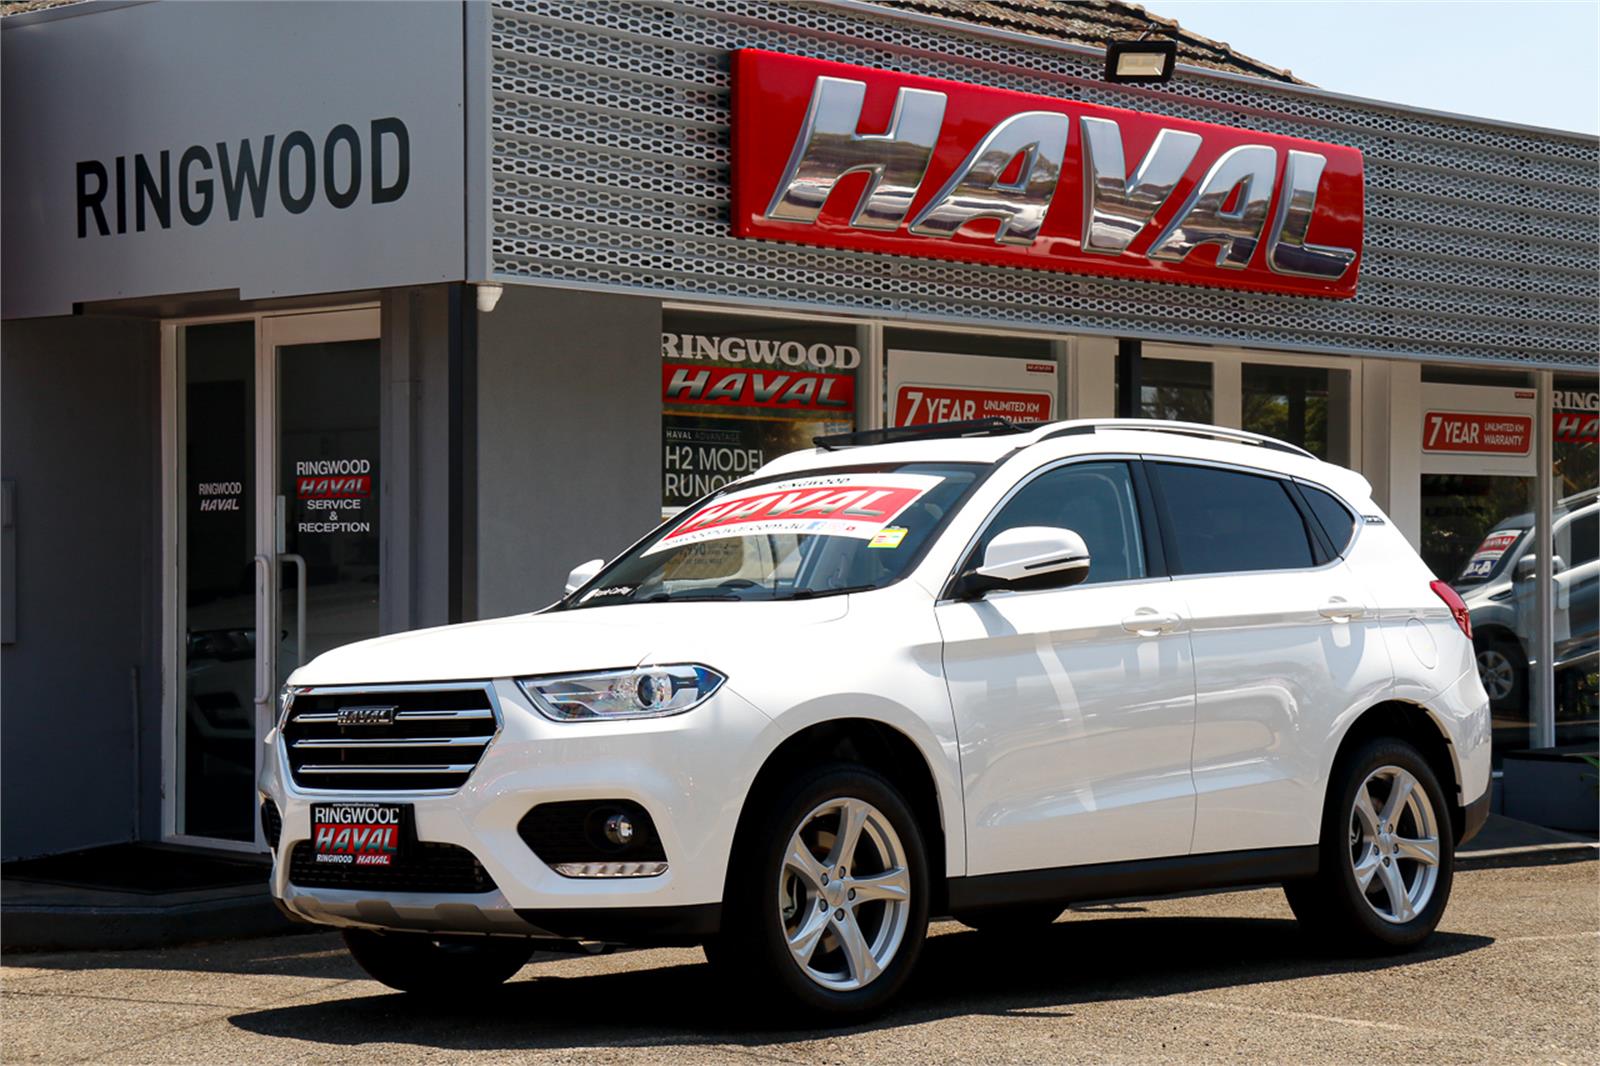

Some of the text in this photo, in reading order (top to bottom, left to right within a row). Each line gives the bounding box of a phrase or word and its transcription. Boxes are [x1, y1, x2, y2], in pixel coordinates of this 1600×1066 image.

[76, 116, 411, 239] RINGWOOD
[764, 75, 1356, 281] HAVAL
[662, 332, 861, 370] RINGWOOD
[665, 368, 848, 406] HAVAL
[904, 392, 976, 426] 7 YEAR
[984, 400, 1040, 413] UNLIMITED KM
[666, 430, 693, 440] HAVAL
[1428, 416, 1480, 447] 7 YEAR
[1484, 422, 1525, 433] UNLIMITED KM
[1484, 434, 1525, 447] WARRANTY
[665, 446, 693, 470] H2
[296, 459, 370, 476] RINGWOOD
[199, 481, 242, 496] RINGWOOD
[300, 477, 368, 496] HAVAL
[200, 498, 240, 512] HAVAL
[307, 499, 361, 510] SERVICE
[678, 488, 896, 533] HAVAL
[329, 511, 338, 521] &
[298, 522, 370, 533] RECEPTION
[315, 827, 398, 852] HAVAL
[316, 853, 390, 865] RINGWOOD HAVAL
